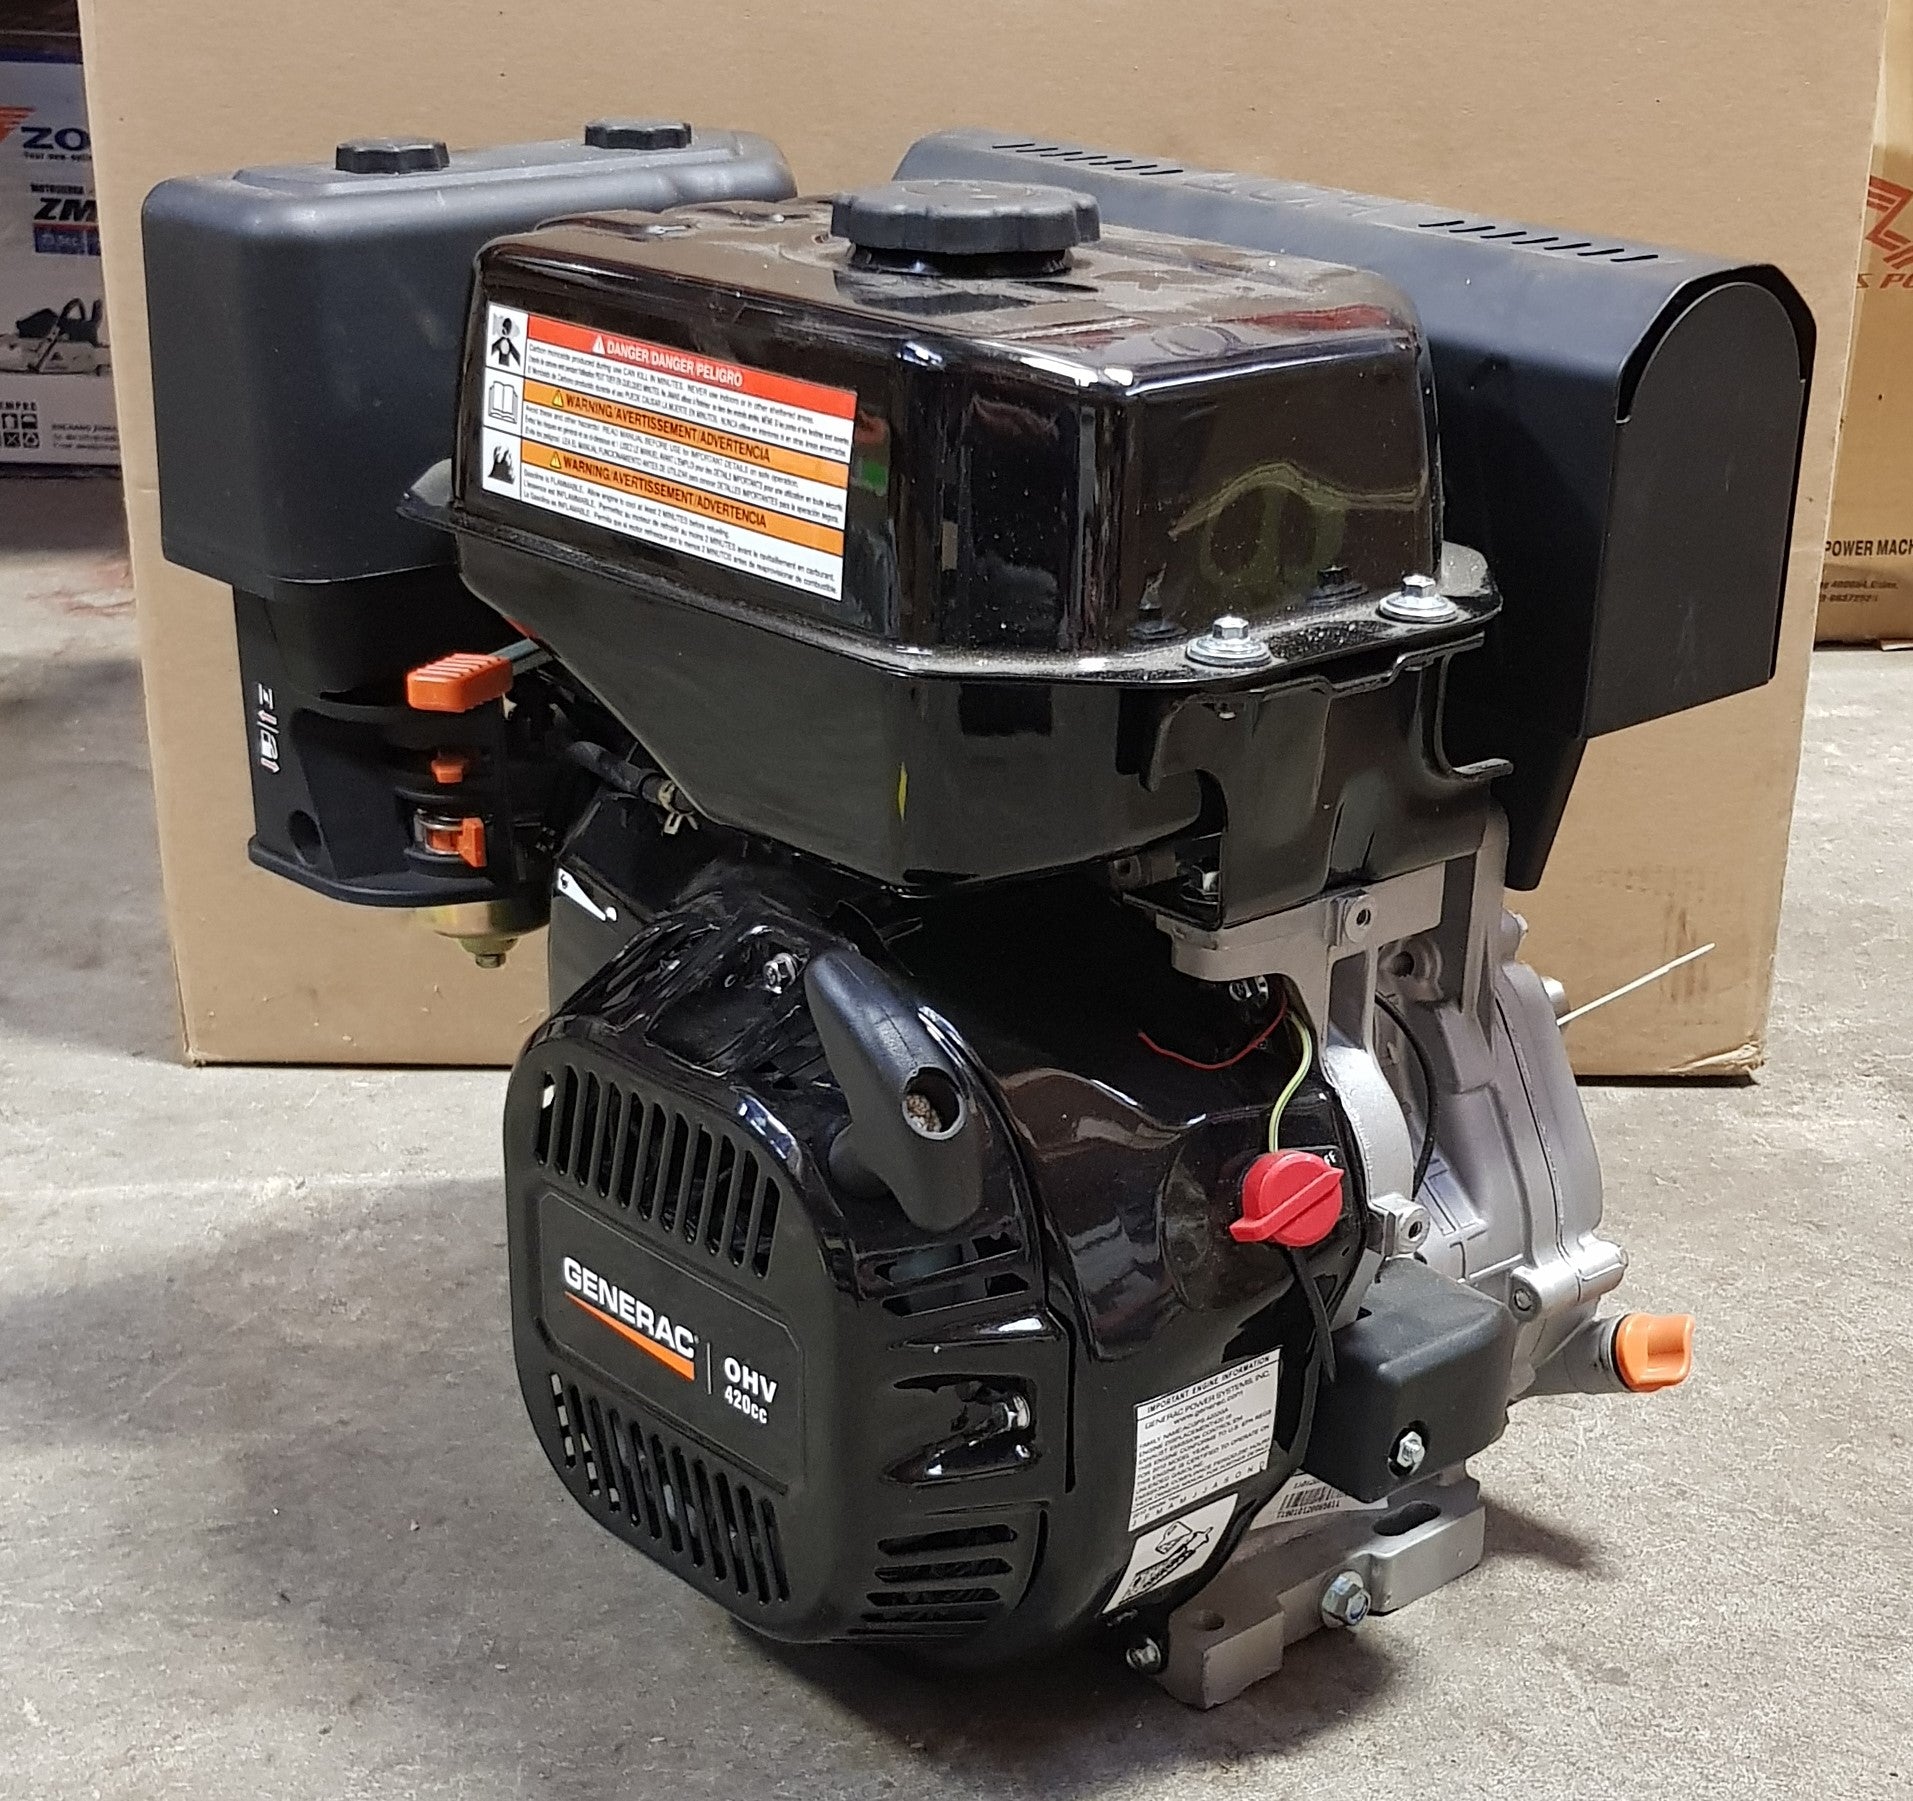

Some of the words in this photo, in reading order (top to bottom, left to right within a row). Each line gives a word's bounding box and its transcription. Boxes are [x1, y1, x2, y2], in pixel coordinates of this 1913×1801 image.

[606, 339, 649, 363] DANGER
[651, 350, 694, 375] DANGER
[696, 361, 743, 387] PELIGRO
[1825, 540, 1873, 556] POWER
[563, 1256, 695, 1358] GENERAC
[724, 1357, 777, 1403] OHV
[1147, 1390, 1189, 1412] IMPORTANT
[1192, 1377, 1219, 1394] ENGINE
[1221, 1356, 1270, 1381] INFORMATION
[1145, 1406, 1184, 1429] GENERAC
[1185, 1394, 1215, 1412] POWER
